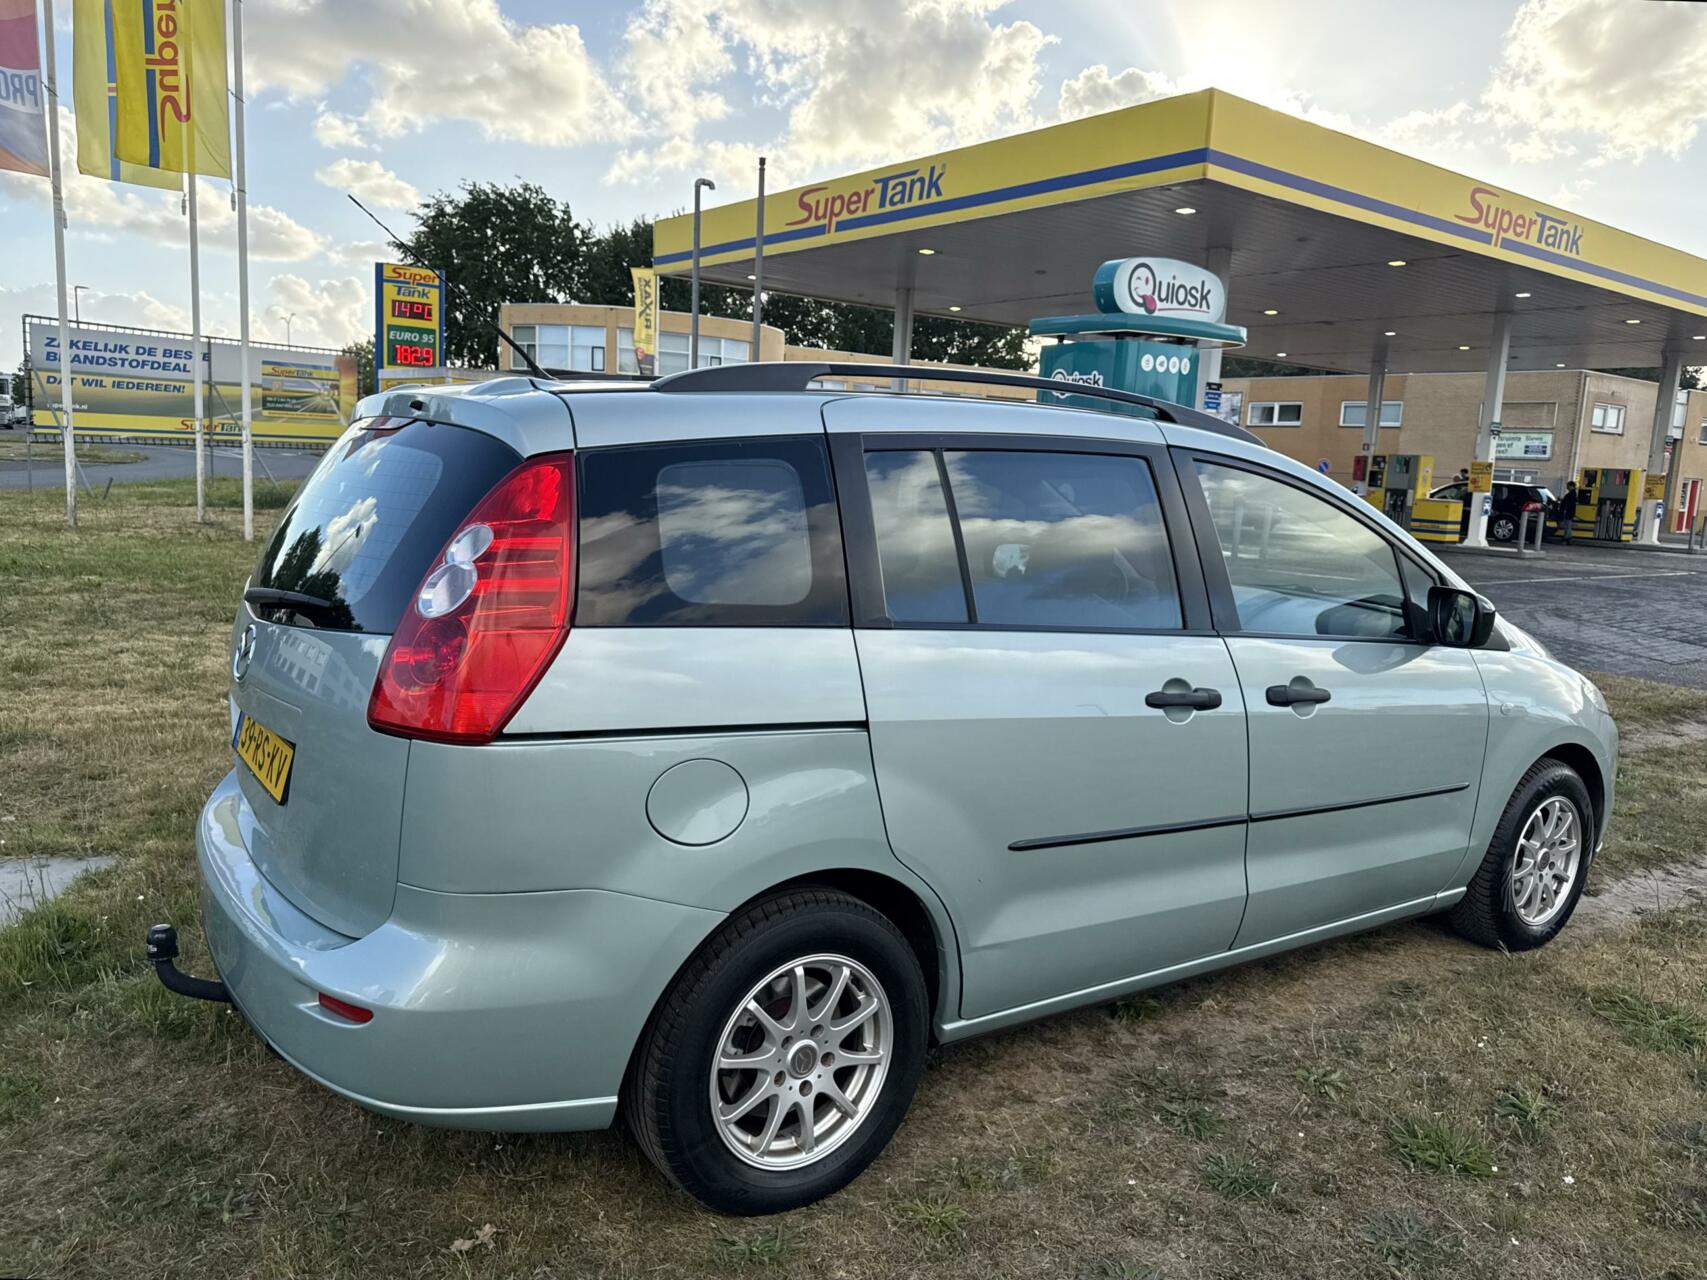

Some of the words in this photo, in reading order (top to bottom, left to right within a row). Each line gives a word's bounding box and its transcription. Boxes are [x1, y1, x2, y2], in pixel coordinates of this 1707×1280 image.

[785, 165, 945, 234] SuperTank
[1454, 187, 1583, 255] SuperTank
[384, 267, 436, 286] Super
[393, 285, 430, 299] Tank
[1128, 262, 1211, 314] Quiosk
[389, 330, 419, 342] EURO
[422, 334, 434, 343] 95
[44, 337, 130, 355] ZKELIJK
[135, 345, 158, 357] DE
[162, 348, 210, 362] BESE
[395, 345, 433, 366] 1829
[45, 351, 191, 373] BANDSTOFDEAL
[46, 375, 77, 386] DT
[81, 378, 107, 388] WIL
[112, 380, 185, 393] IEDEREEN!
[241, 716, 288, 789] 39-RS-KV
